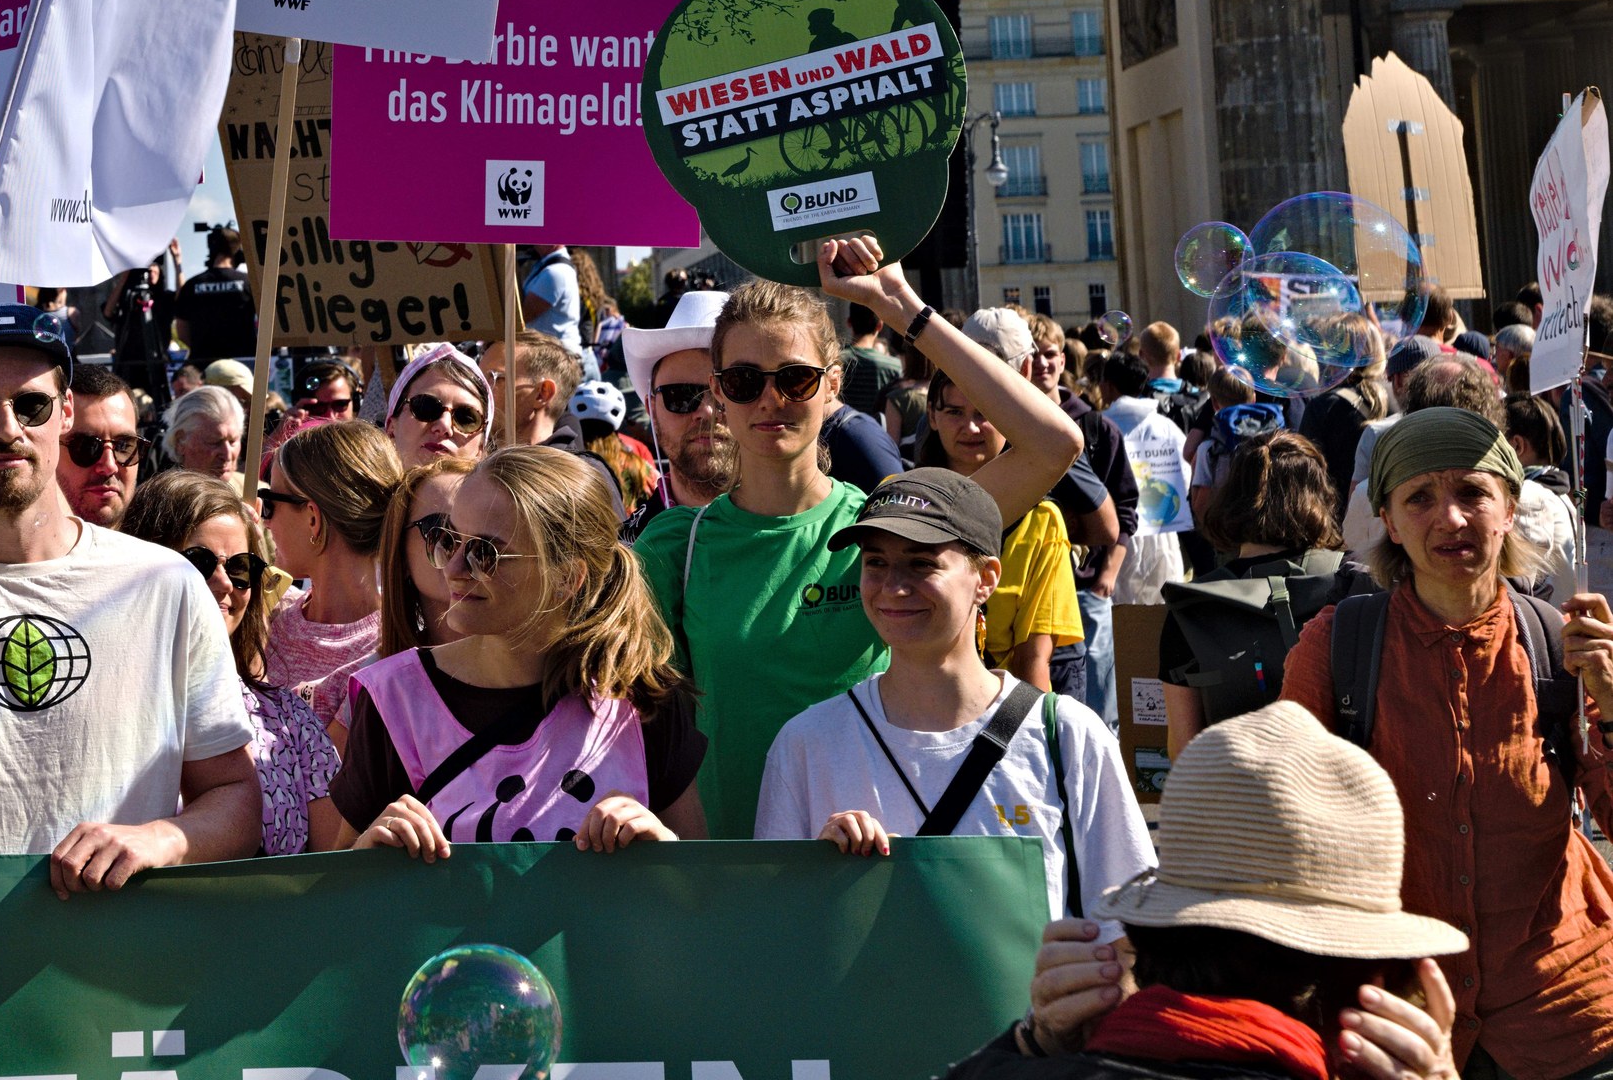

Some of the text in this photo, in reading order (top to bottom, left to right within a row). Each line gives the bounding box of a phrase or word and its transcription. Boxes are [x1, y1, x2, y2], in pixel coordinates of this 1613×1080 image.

[445, 22, 558, 66] rbie
[570, 30, 656, 68] want
[666, 33, 932, 117] WIESEN UND WALD
[388, 78, 644, 135] das Klimageld!
[681, 64, 935, 148] STATT ASPHALT
[227, 119, 331, 160] NAH
[497, 208, 532, 219] WWF
[805, 188, 858, 210] BUND
[820, 209, 836, 217] EARTH
[837, 205, 861, 214] GERMANY
[276, 273, 472, 342] flieger!
[1144, 448, 1175, 459] DUMP
[826, 584, 862, 602] BUN
